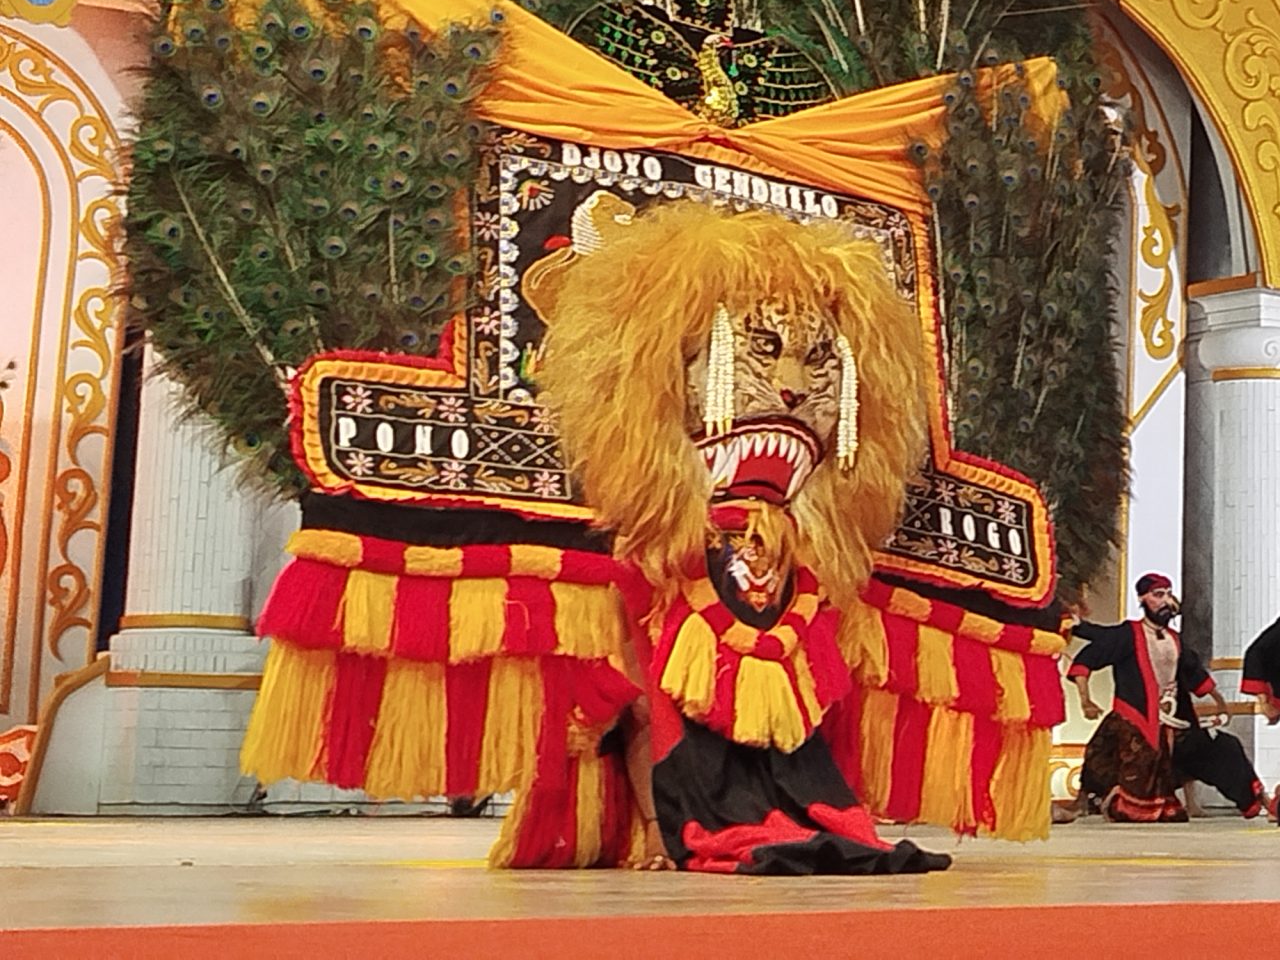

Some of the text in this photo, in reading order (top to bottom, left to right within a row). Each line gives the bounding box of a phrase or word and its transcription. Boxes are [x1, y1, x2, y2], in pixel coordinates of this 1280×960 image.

[562, 143, 839, 219] DJOYO GENDHILO
[337, 416, 470, 459] PONO
[939, 507, 1022, 555] ROGO
